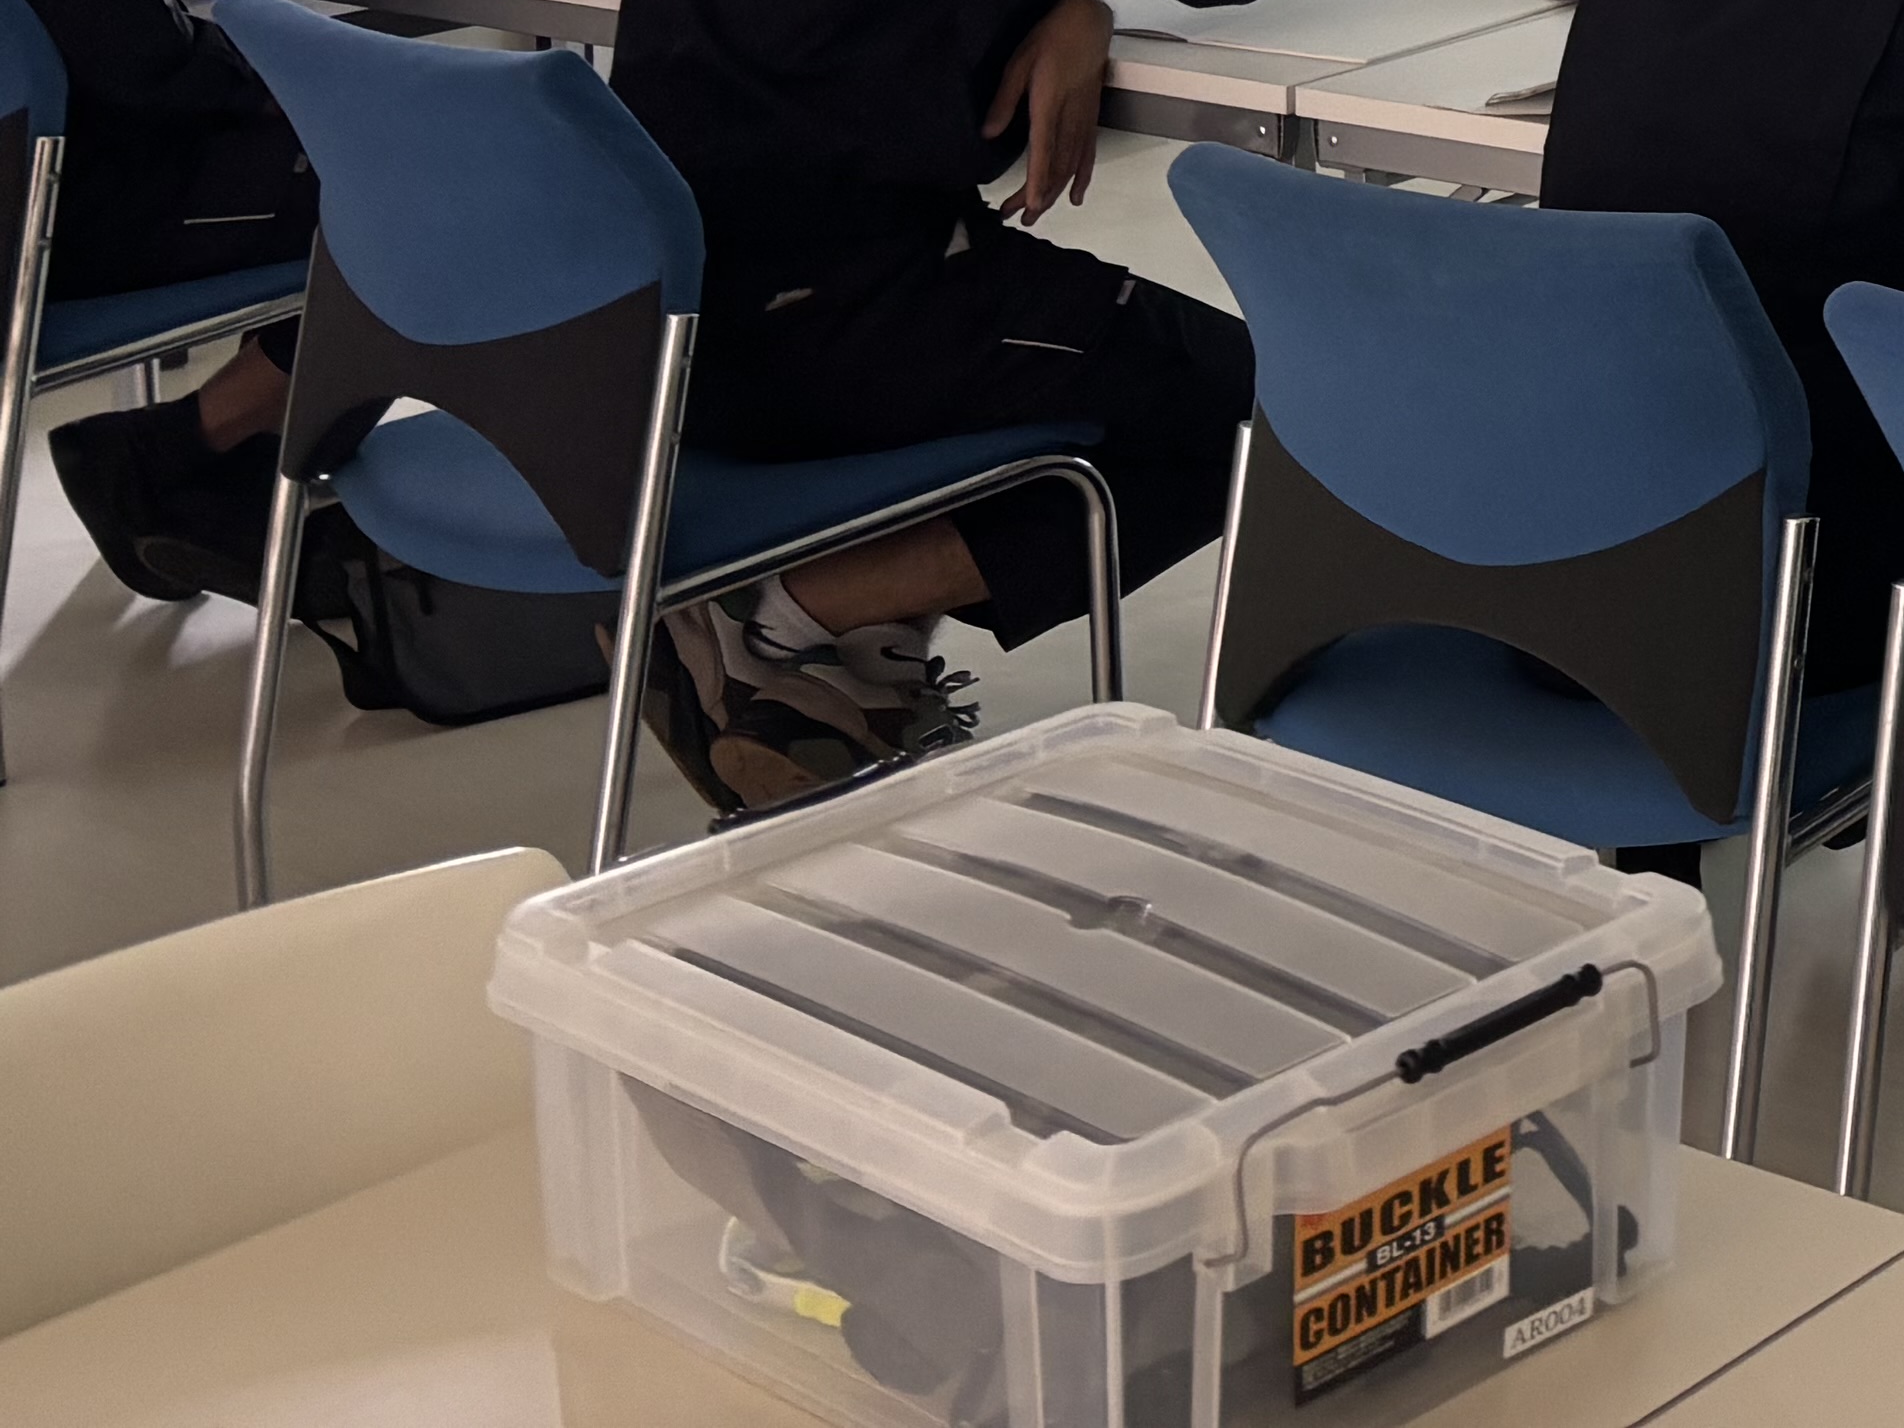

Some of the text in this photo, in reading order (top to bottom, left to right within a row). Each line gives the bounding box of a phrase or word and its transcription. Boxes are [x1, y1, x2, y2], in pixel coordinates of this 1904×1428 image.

[1300, 1139, 1507, 1278] BUCKLE
[1375, 1221, 1437, 1266] BL-13
[1298, 1211, 1506, 1352] CONTAINER
[1511, 1296, 1588, 1351] AR004
